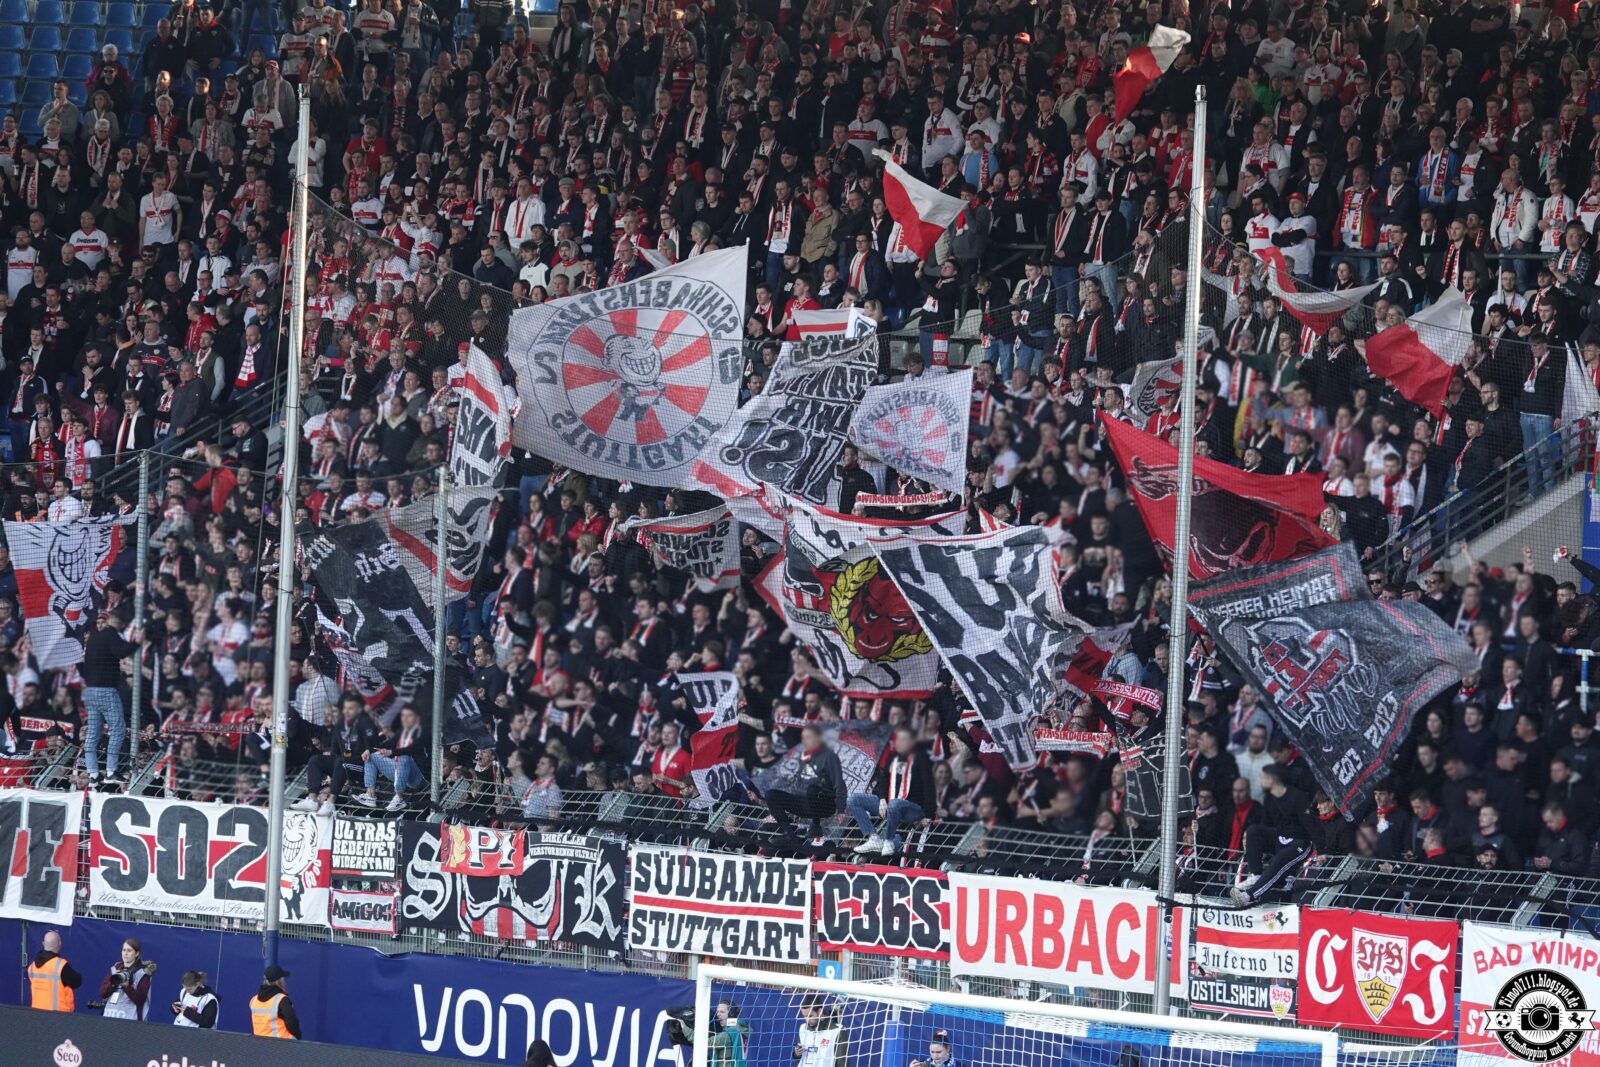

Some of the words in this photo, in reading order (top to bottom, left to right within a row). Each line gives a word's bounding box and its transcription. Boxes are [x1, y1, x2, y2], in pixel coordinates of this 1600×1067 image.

[1267, 572, 1333, 608] HEIMAT
[334, 820, 396, 842] ULTRAS
[333, 839, 396, 857] BEDEUTET
[575, 850, 597, 861] ULTRAS
[331, 855, 396, 870] WIDERSTAND
[635, 851, 810, 907] SÜDBANDE
[822, 870, 942, 952] C36S
[631, 908, 804, 960] STUTTGART
[1201, 946, 1267, 972] Inferno
[1473, 943, 1523, 974] BAD
[1190, 980, 1268, 1008] OSTELSHEIM
[57, 1048, 80, 1063] Seco
